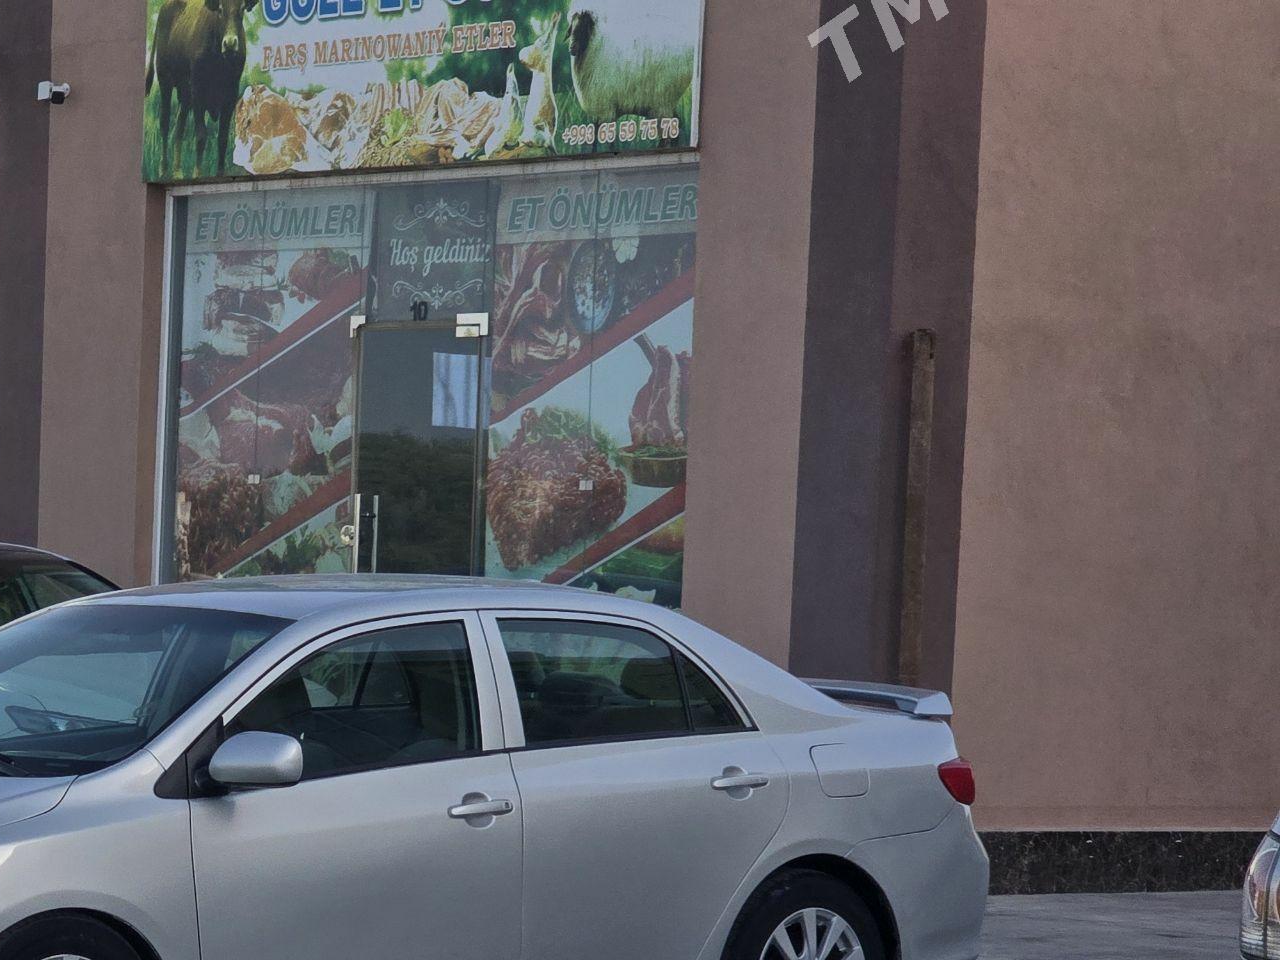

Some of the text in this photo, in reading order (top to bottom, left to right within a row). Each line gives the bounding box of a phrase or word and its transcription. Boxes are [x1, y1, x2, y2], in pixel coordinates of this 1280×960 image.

[261, 43, 307, 74] FARŞ
[451, 20, 517, 54] ETLER
[562, 117, 680, 146] +993 65 59 75 78
[195, 211, 226, 242] ET
[507, 195, 545, 233] ET
[390, 238, 419, 273] Hoş
[410, 300, 428, 321] 10
